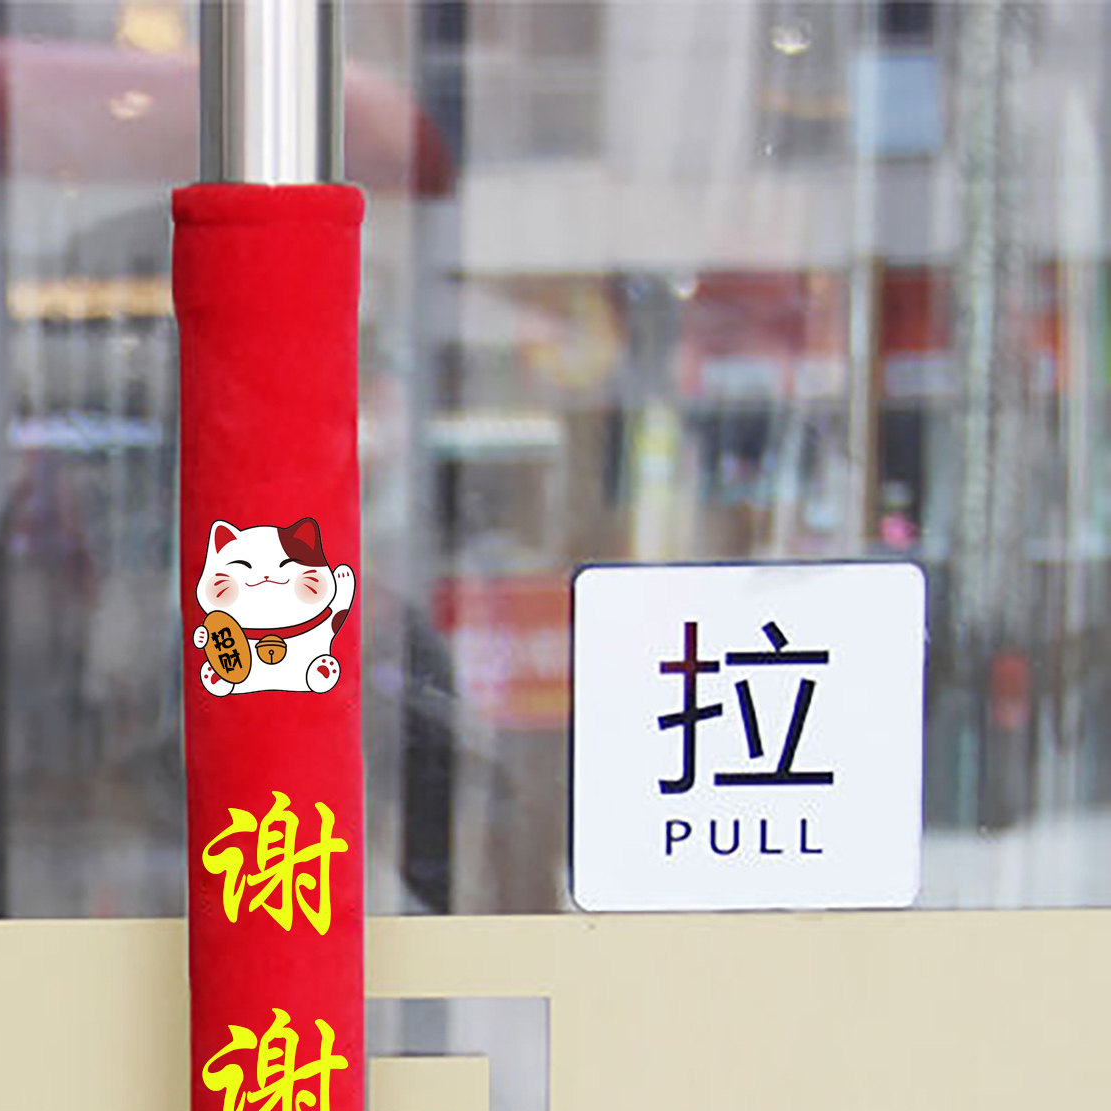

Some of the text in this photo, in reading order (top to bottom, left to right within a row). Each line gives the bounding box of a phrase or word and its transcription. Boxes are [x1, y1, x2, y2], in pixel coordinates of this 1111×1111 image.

[211, 626, 243, 674] 招财
[658, 621, 834, 795] 拉
[665, 818, 824, 857] PULL
